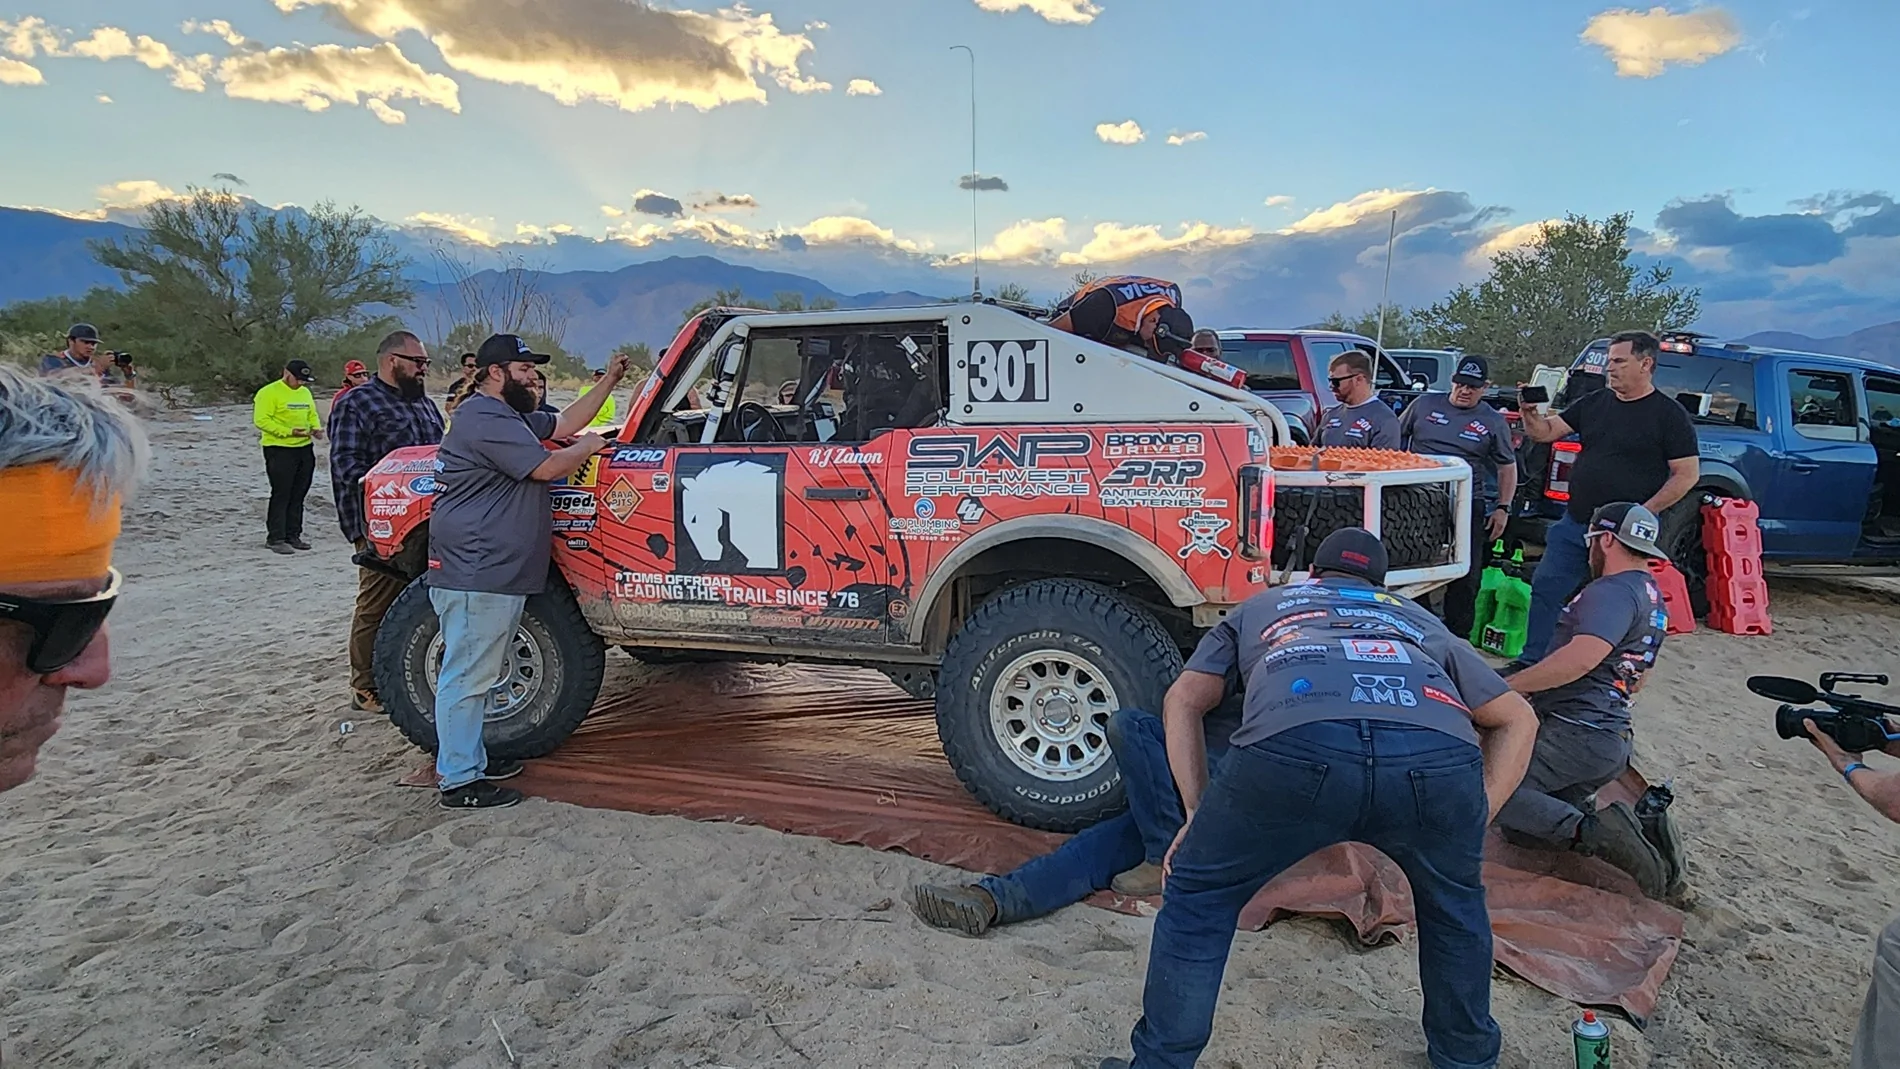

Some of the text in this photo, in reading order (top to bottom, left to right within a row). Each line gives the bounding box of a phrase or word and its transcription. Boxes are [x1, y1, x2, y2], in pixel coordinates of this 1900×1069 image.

[1586, 351, 1608, 366] 301
[969, 340, 1047, 402] 301
[1356, 418, 1372, 431] 301
[1469, 420, 1489, 435] 301
[1106, 433, 1203, 446] BRONCO
[613, 449, 667, 462] FORD
[906, 432, 1091, 469] SWP
[1108, 443, 1200, 455] DRIVER
[808, 448, 884, 468] RJ Zanon
[905, 469, 1090, 485] SOUTHWEST
[1100, 460, 1206, 486] PRP
[905, 484, 1090, 497] PERFORMANCE
[1099, 488, 1206, 498] ANTIGRAVITY
[372, 504, 408, 516] OFFROAD
[1102, 498, 1203, 507] BATTERIES
[889, 518, 960, 530] GO PLUMBING
[906, 527, 944, 535] AND MORE
[622, 571, 732, 588] TOMS OFFROAD
[614, 583, 860, 608] LEADING THE TRAIL SINCE '76
[1071, 634, 1103, 657] T/A
[971, 630, 1061, 691] All-Terrain
[1350, 686, 1418, 708] AMB
[1014, 770, 1122, 805] FGoodrich
